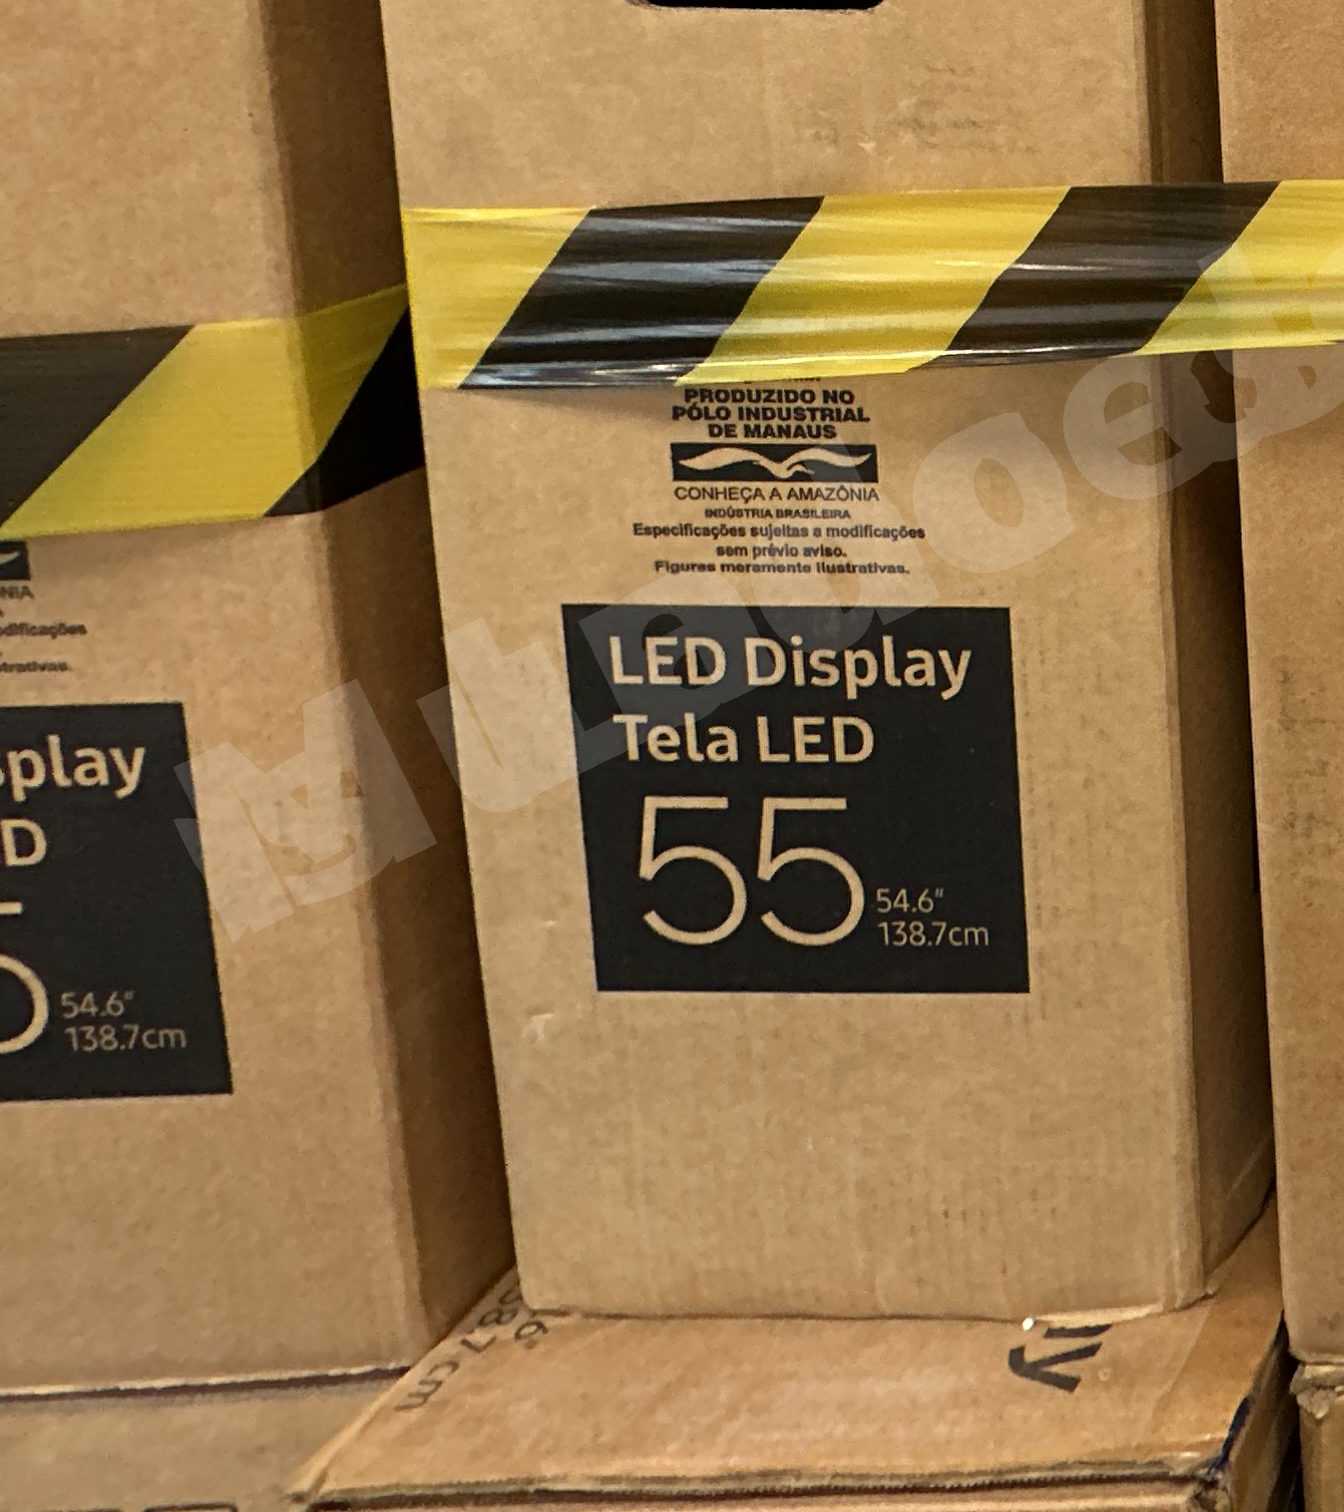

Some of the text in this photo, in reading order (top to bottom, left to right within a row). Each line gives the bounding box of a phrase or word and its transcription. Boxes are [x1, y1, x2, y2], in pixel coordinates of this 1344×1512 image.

[684, 389, 854, 404] PRODUZIDO NO
[672, 402, 870, 422] PÓLO INDUSTRIAL
[708, 424, 837, 438] DE MANAUS
[674, 485, 879, 503] CONHEÇA A AMAZÔNIA
[704, 507, 850, 519] INDÚSTRIA BRASILEIRA
[633, 524, 925, 540] Especificações sujeitas modificações
[716, 546, 748, 557] sem
[752, 544, 798, 559] prévio
[654, 561, 811, 574] Figuras meramente
[610, 635, 971, 700] LED Display
[612, 713, 874, 763] Tela LED
[638, 795, 866, 945] 55
[878, 921, 989, 947] 138.7cm
[66, 1024, 186, 1050] 138.7cm
